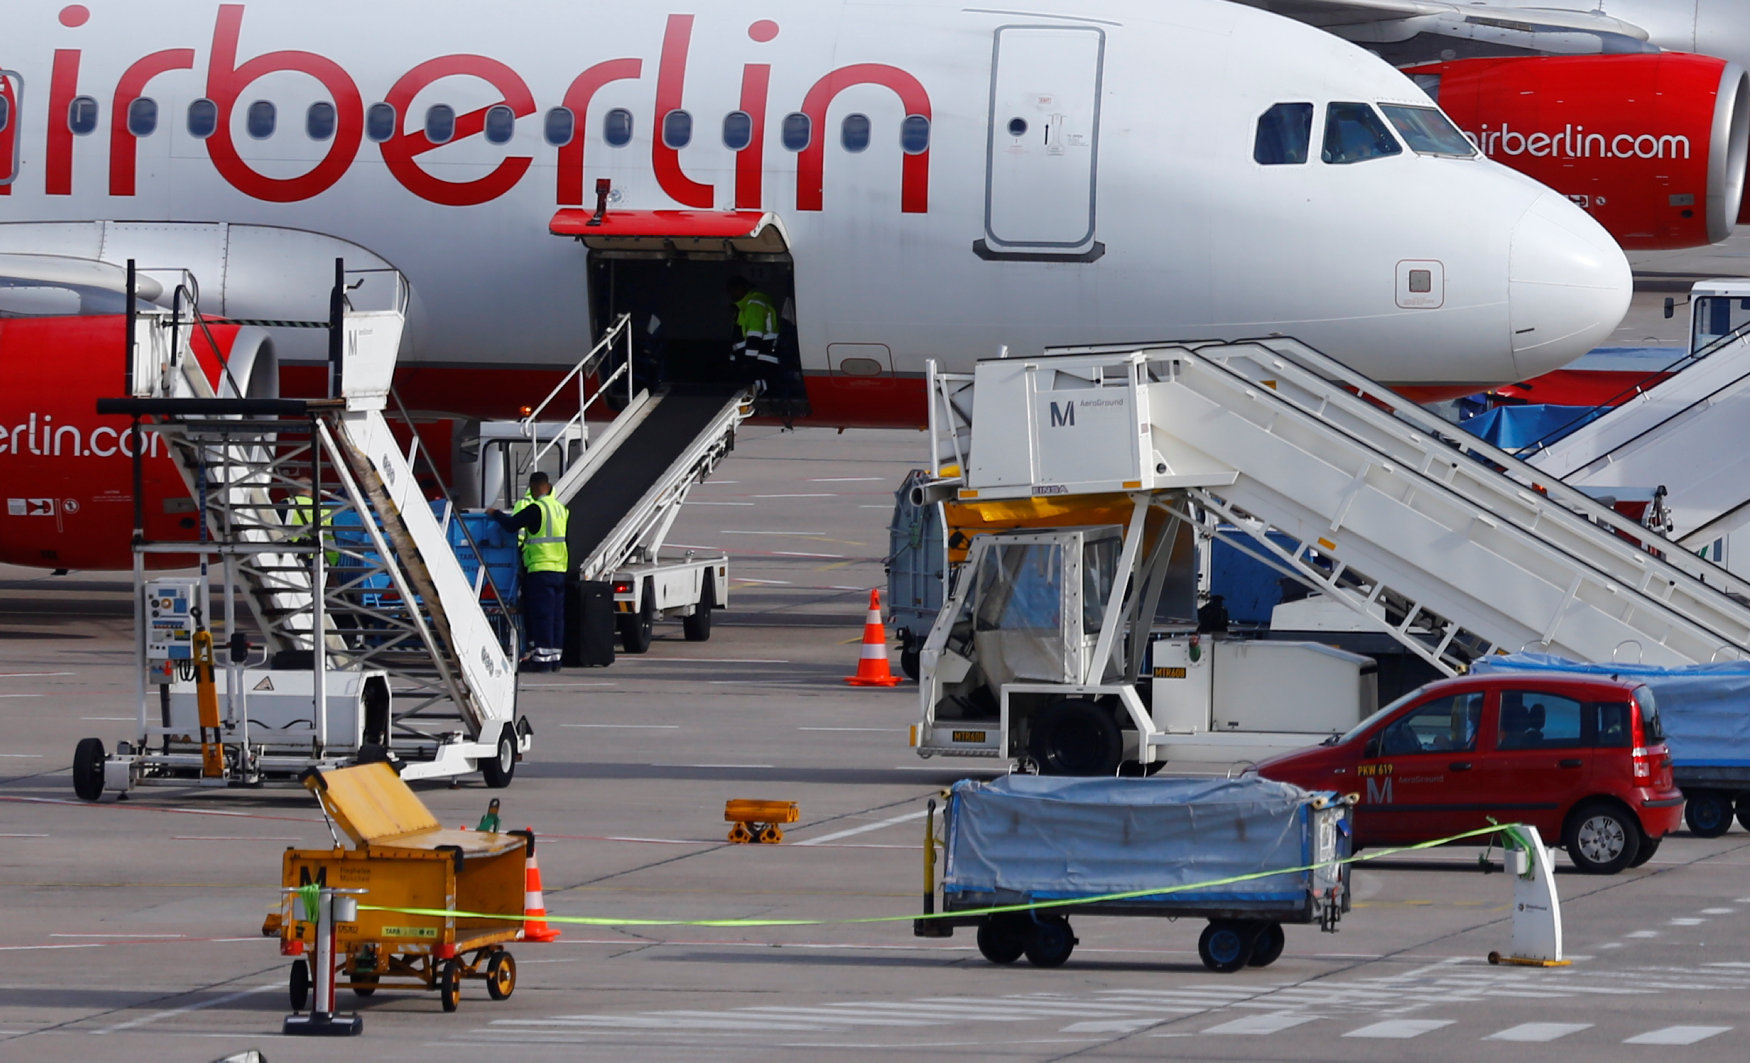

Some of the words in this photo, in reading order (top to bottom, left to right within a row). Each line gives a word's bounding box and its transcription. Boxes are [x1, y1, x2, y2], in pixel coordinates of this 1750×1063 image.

[0, 4, 932, 214] irberlin
[348, 329, 358, 356] M
[1050, 400, 1075, 427] M
[1080, 398, 1124, 407] AeroGround
[1358, 765, 1376, 776] PKW
[1378, 764, 1393, 774] 619
[1366, 776, 1393, 804] M
[300, 865, 327, 888] M
